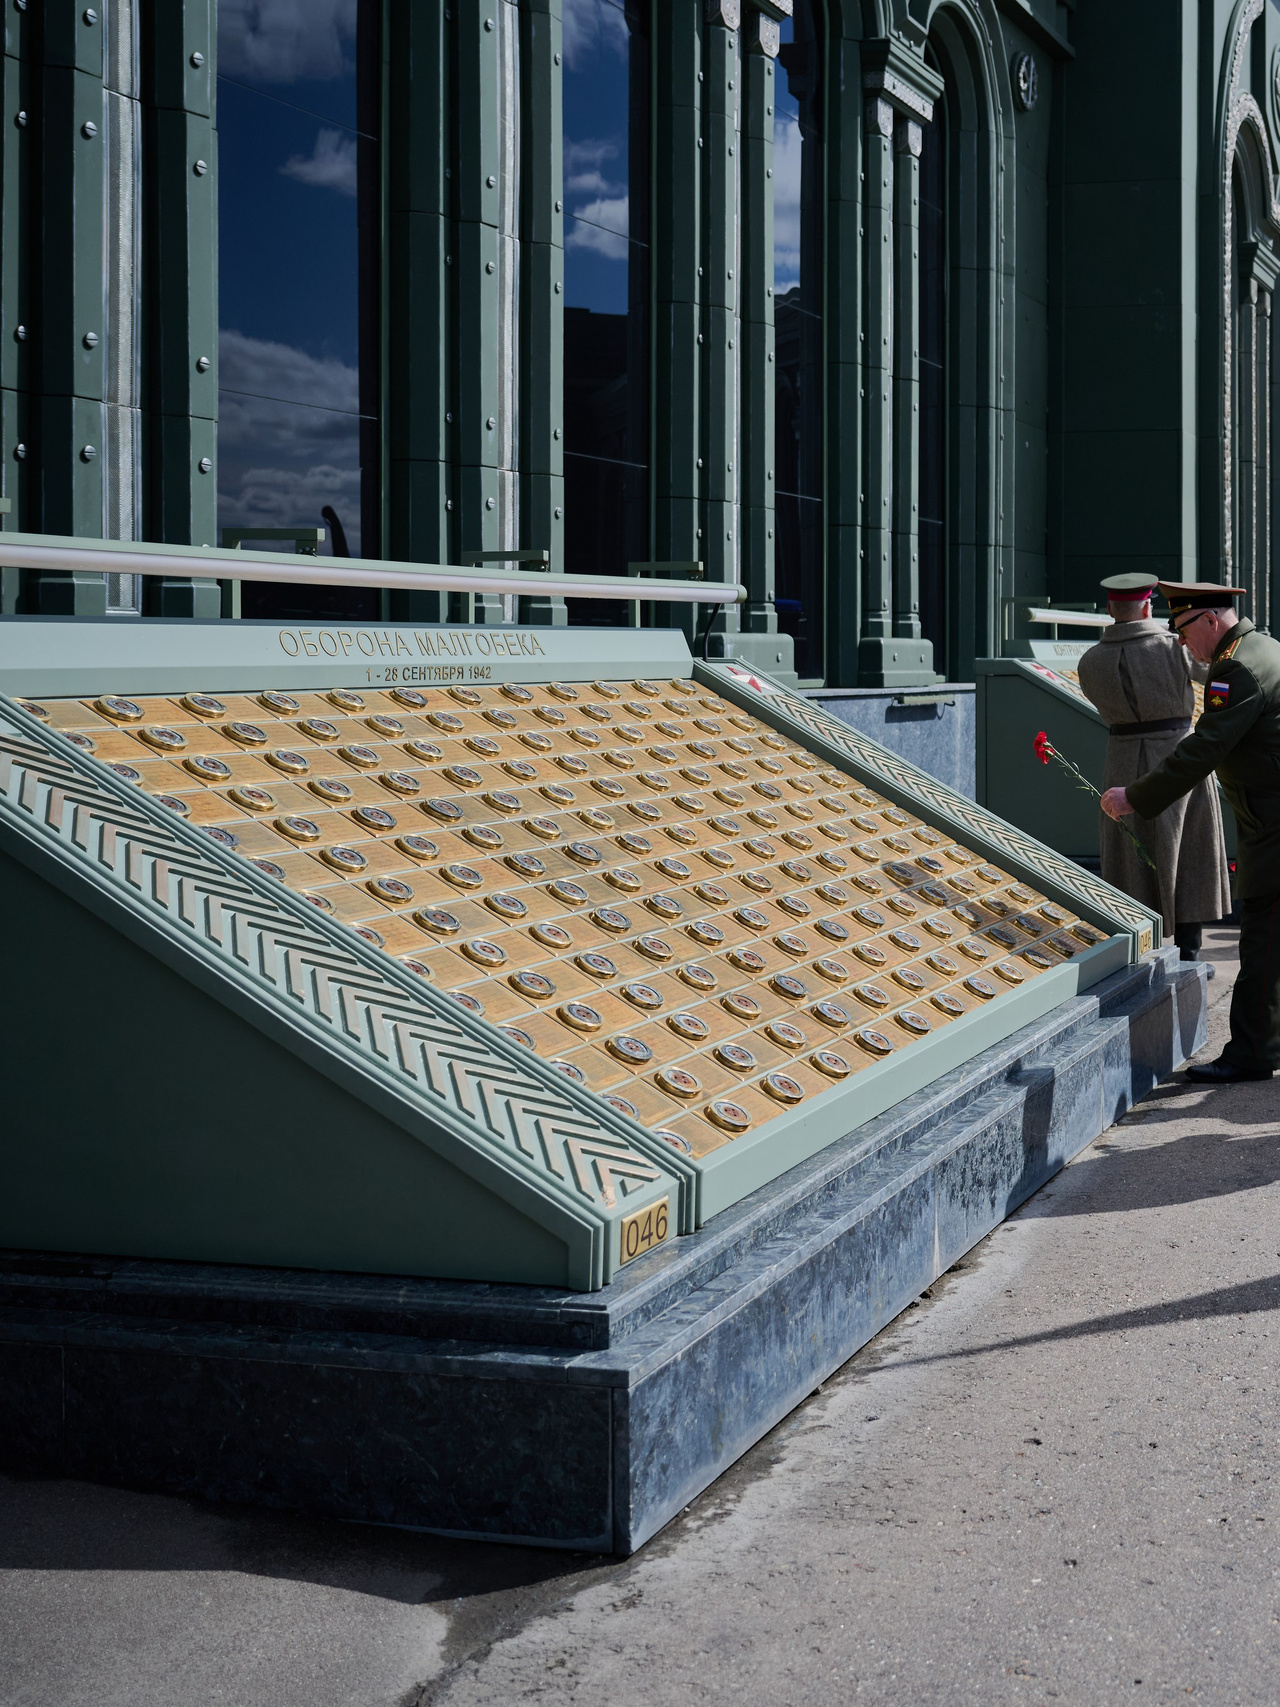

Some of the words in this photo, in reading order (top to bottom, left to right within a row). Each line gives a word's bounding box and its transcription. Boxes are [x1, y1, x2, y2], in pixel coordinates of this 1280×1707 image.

[279, 629, 413, 657] ОБОРОНА
[413, 631, 546, 657] МАЛГОБЕКА
[365, 667, 372, 682] 1
[384, 666, 399, 682] 28
[402, 665, 464, 681] СЕНТЯБРЯ
[468, 665, 492, 680] 1942
[1140, 930, 1152, 954] 046
[626, 1203, 668, 1258] 046
